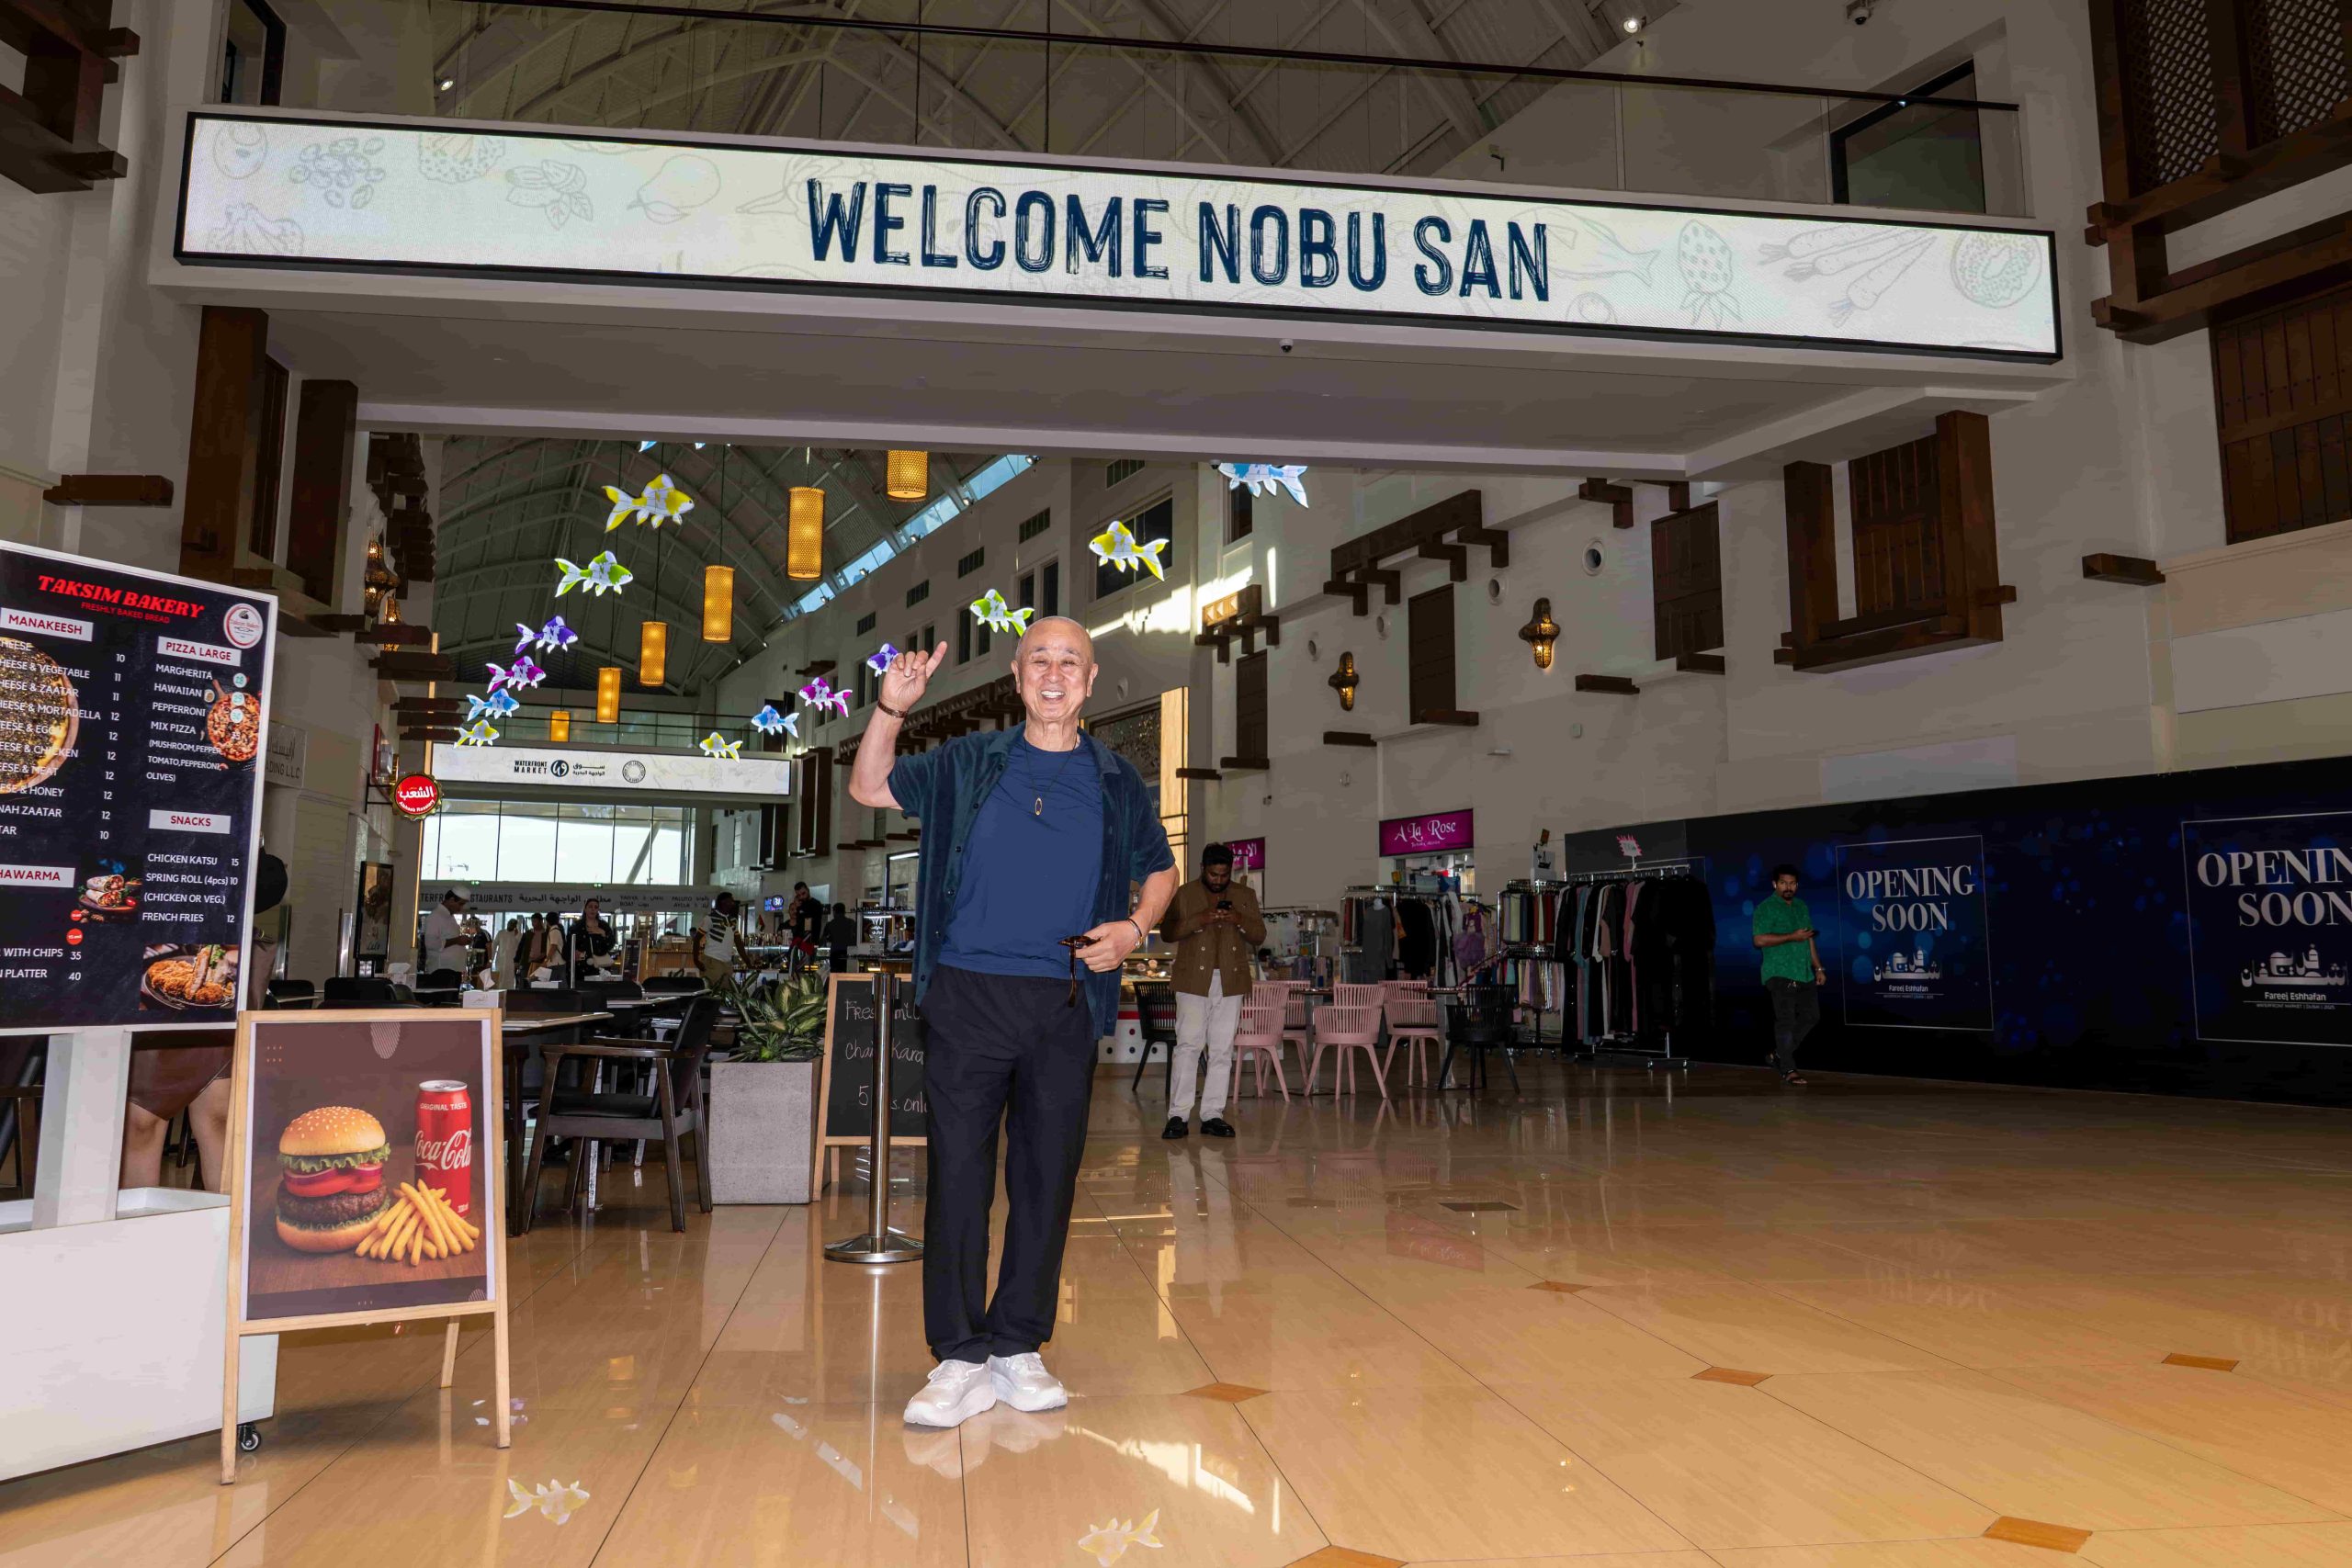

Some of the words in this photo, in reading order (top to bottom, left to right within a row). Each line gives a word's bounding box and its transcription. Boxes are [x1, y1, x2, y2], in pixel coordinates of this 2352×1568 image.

[807, 177, 1170, 280] WELCOME
[1199, 201, 1387, 292] NOBU
[1414, 215, 1550, 302] SAN
[38, 574, 123, 604] TAKSIM
[122, 591, 206, 618] BAKERY
[81, 602, 117, 615] FRESHLY
[118, 608, 143, 619] BAKED
[145, 613, 170, 624] BREAD
[8, 615, 83, 635] MANAKEESH
[0, 641, 32, 651] HEESE
[116, 654, 126, 662] 10
[166, 641, 197, 655] PIZZA
[199, 648, 232, 660] LARGE
[29, 662, 37, 671] &
[39, 663, 90, 679] VEGETABLE
[114, 673, 121, 682] 11
[155, 664, 212, 681] MARGHERITA
[29, 682, 37, 693] &
[40, 684, 79, 697] ZAATAR
[113, 693, 119, 701] 11
[153, 683, 202, 698] HAWAIIAN
[28, 704, 36, 713] &
[38, 705, 101, 720] MORTADELLA
[111, 712, 119, 720] 12
[153, 703, 206, 716] PEPPERRONI
[26, 724, 33, 733] &
[108, 732, 118, 740] 12
[151, 721, 169, 731] MIX
[170, 723, 197, 734] PIZZA
[24, 744, 31, 753] &
[107, 751, 116, 760] 12
[514, 760, 547, 768] WATERFRONT
[22, 765, 29, 773] &
[106, 772, 114, 780] 12
[146, 772, 175, 783] OLIVES)
[29, 786, 64, 797] HONEY
[104, 791, 112, 800] 12
[398, 785, 435, 800] الشعب
[22, 806, 62, 818] ZAATAR
[101, 811, 110, 820] 12
[170, 815, 211, 827] SNACKS
[100, 831, 109, 840] 10
[1394, 825, 1408, 842] A
[1407, 822, 1423, 842] La
[1427, 819, 1456, 840] Rose
[147, 853, 188, 864] CHICKEN
[189, 855, 218, 865] KATSU
[232, 858, 239, 866] 15
[2198, 847, 2352, 887] OPENIN
[146, 873, 179, 883] SPRING
[181, 874, 203, 884] ROLL
[204, 875, 228, 886] (4pcs)
[230, 876, 238, 886] 10
[1846, 865, 1975, 900] OPENING
[144, 893, 187, 903] (CHICKEN
[189, 895, 201, 903] OR
[204, 895, 226, 905] VEG.)
[2238, 890, 2352, 927] SOON
[142, 912, 178, 921] FRENCH
[179, 913, 204, 922] FRIES
[227, 915, 234, 923] 12
[1871, 901, 1949, 932] SOON
[4, 948, 31, 957] WITH
[33, 948, 63, 957] CHIPS
[70, 951, 82, 960] 35
[6, 969, 48, 978] PLATTER
[69, 972, 81, 981] 40
[2265, 991, 2289, 1001] Fareej
[2290, 992, 2326, 1001] Eshhafan
[858, 1085, 869, 1106] 5
[420, 1102, 448, 1111] ORIGINAL
[450, 1101, 468, 1110] TASTE
